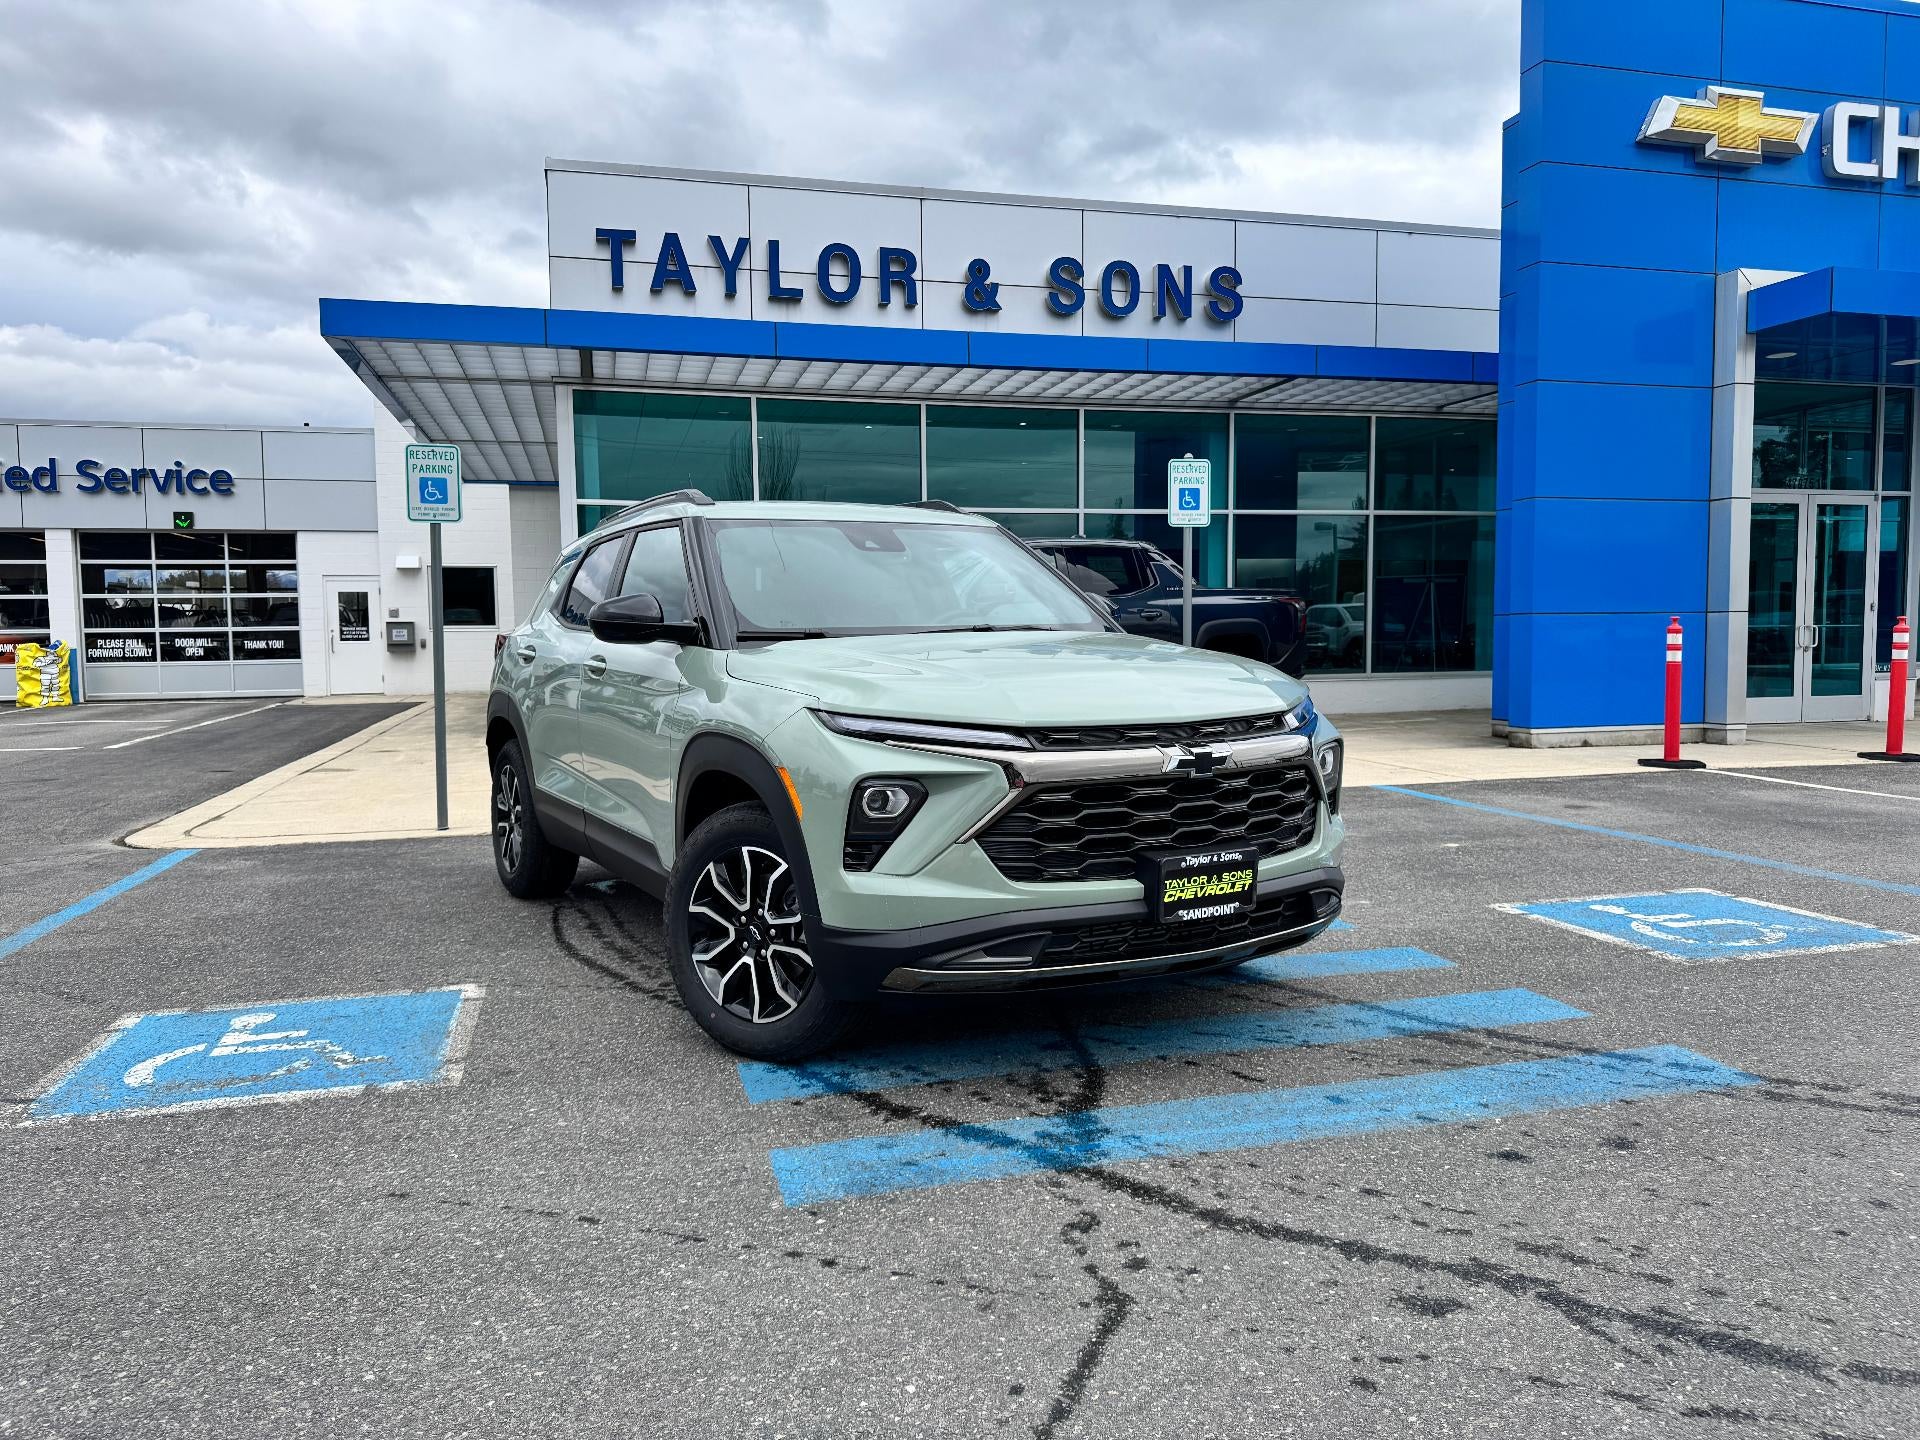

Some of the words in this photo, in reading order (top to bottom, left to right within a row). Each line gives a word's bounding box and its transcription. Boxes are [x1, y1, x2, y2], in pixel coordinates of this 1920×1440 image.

[595, 227, 919, 308] TAYLOR
[963, 257, 1003, 312] &
[1046, 256, 1245, 323] SONS
[409, 449, 455, 461] RESERVED
[412, 463, 453, 474] PARKING
[1172, 464, 1207, 474] RESERVED
[0, 458, 59, 493] ed
[75, 459, 235, 495] Service
[1173, 476, 1205, 485] PARKING
[97, 639, 124, 648] PLEASE
[125, 639, 144, 648] PULL
[174, 638, 194, 647] DOOR
[195, 638, 213, 646] WILL
[244, 640, 267, 649] THANK
[267, 640, 285, 648] YOU!
[88, 648, 124, 658] FORWARD
[124, 648, 153, 657] SLOWLY
[185, 648, 204, 656] OPEN
[1186, 855, 1211, 867] Taylor
[1219, 852, 1238, 862] Sons
[1164, 875, 1207, 889] TAYLOR
[1210, 875, 1219, 885] &
[1222, 869, 1253, 880] SONS
[1163, 880, 1253, 903] CHEVROLET
[1183, 903, 1236, 921] SANDPOINT
